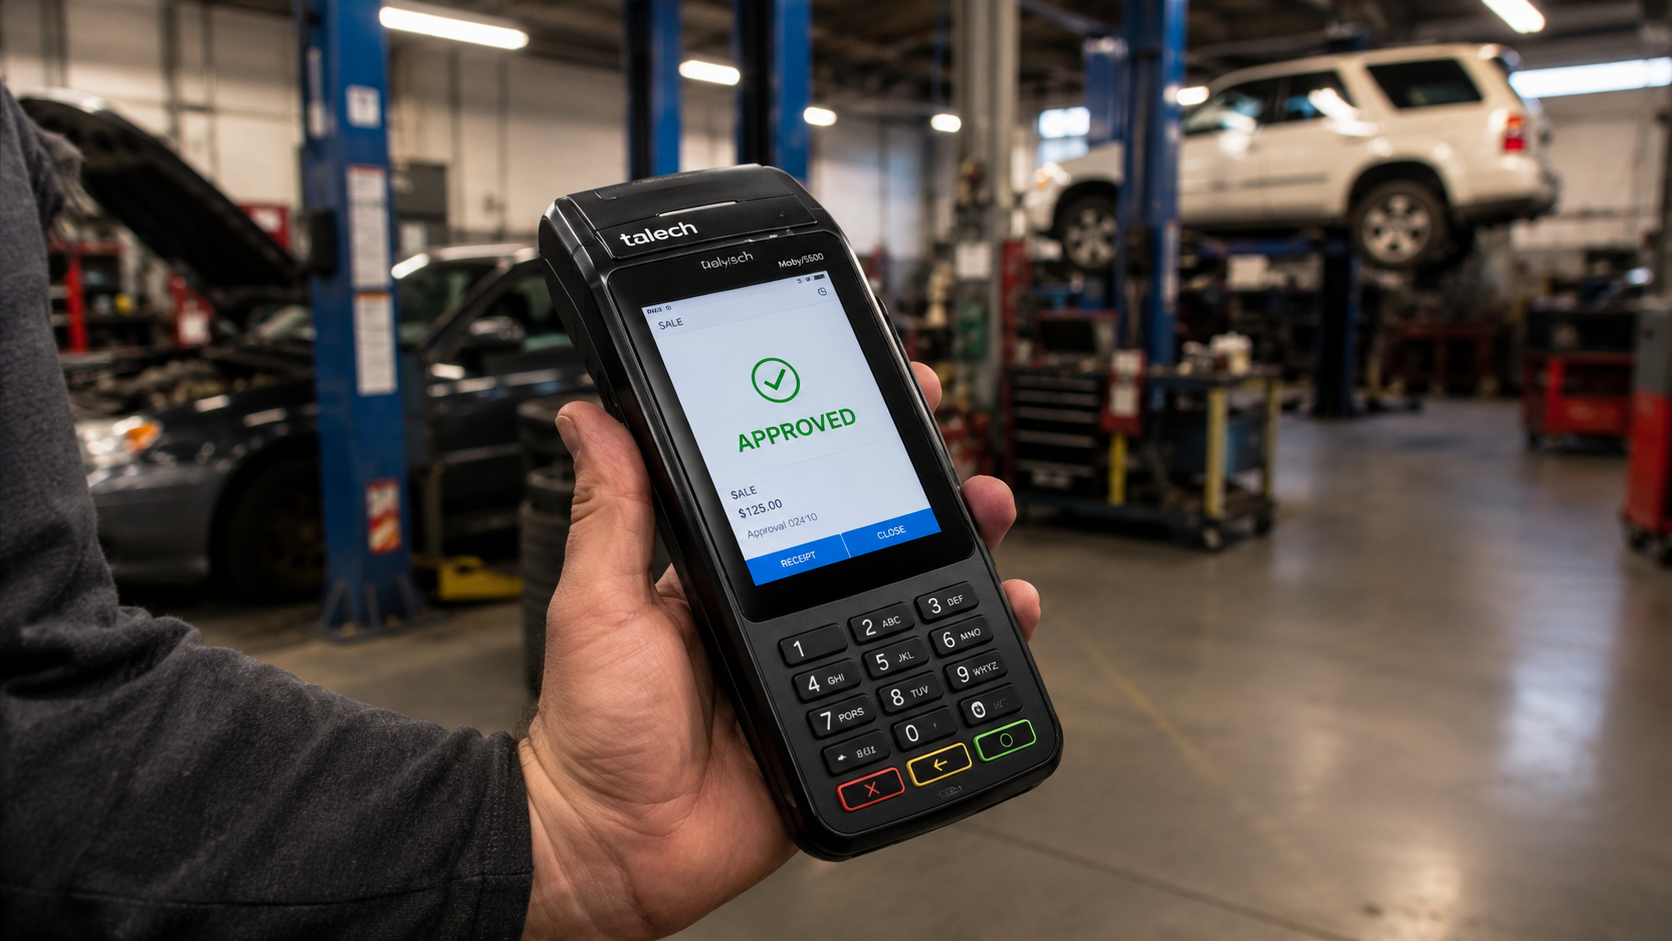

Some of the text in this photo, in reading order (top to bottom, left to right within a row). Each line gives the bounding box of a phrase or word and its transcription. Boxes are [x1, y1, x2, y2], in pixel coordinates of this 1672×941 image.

[619, 221, 698, 247] talech
[658, 317, 684, 330] SALE
[738, 408, 856, 453] APPROVED
[730, 485, 758, 500] SALE
[738, 498, 783, 519] $125.00
[747, 521, 788, 539] Approval
[877, 525, 906, 540] CLOSE
[780, 551, 816, 568] RECEIPT
[928, 594, 964, 614] 3 DEF
[861, 615, 901, 636] 2 ABC
[942, 631, 956, 648] 6
[793, 640, 805, 658] 1
[875, 651, 915, 671] 5 JKL
[808, 673, 845, 692] 4 GHI
[956, 665, 970, 683] 9
[890, 685, 929, 706] 8 TUV
[820, 711, 832, 731] 7
[905, 724, 919, 742] 0
